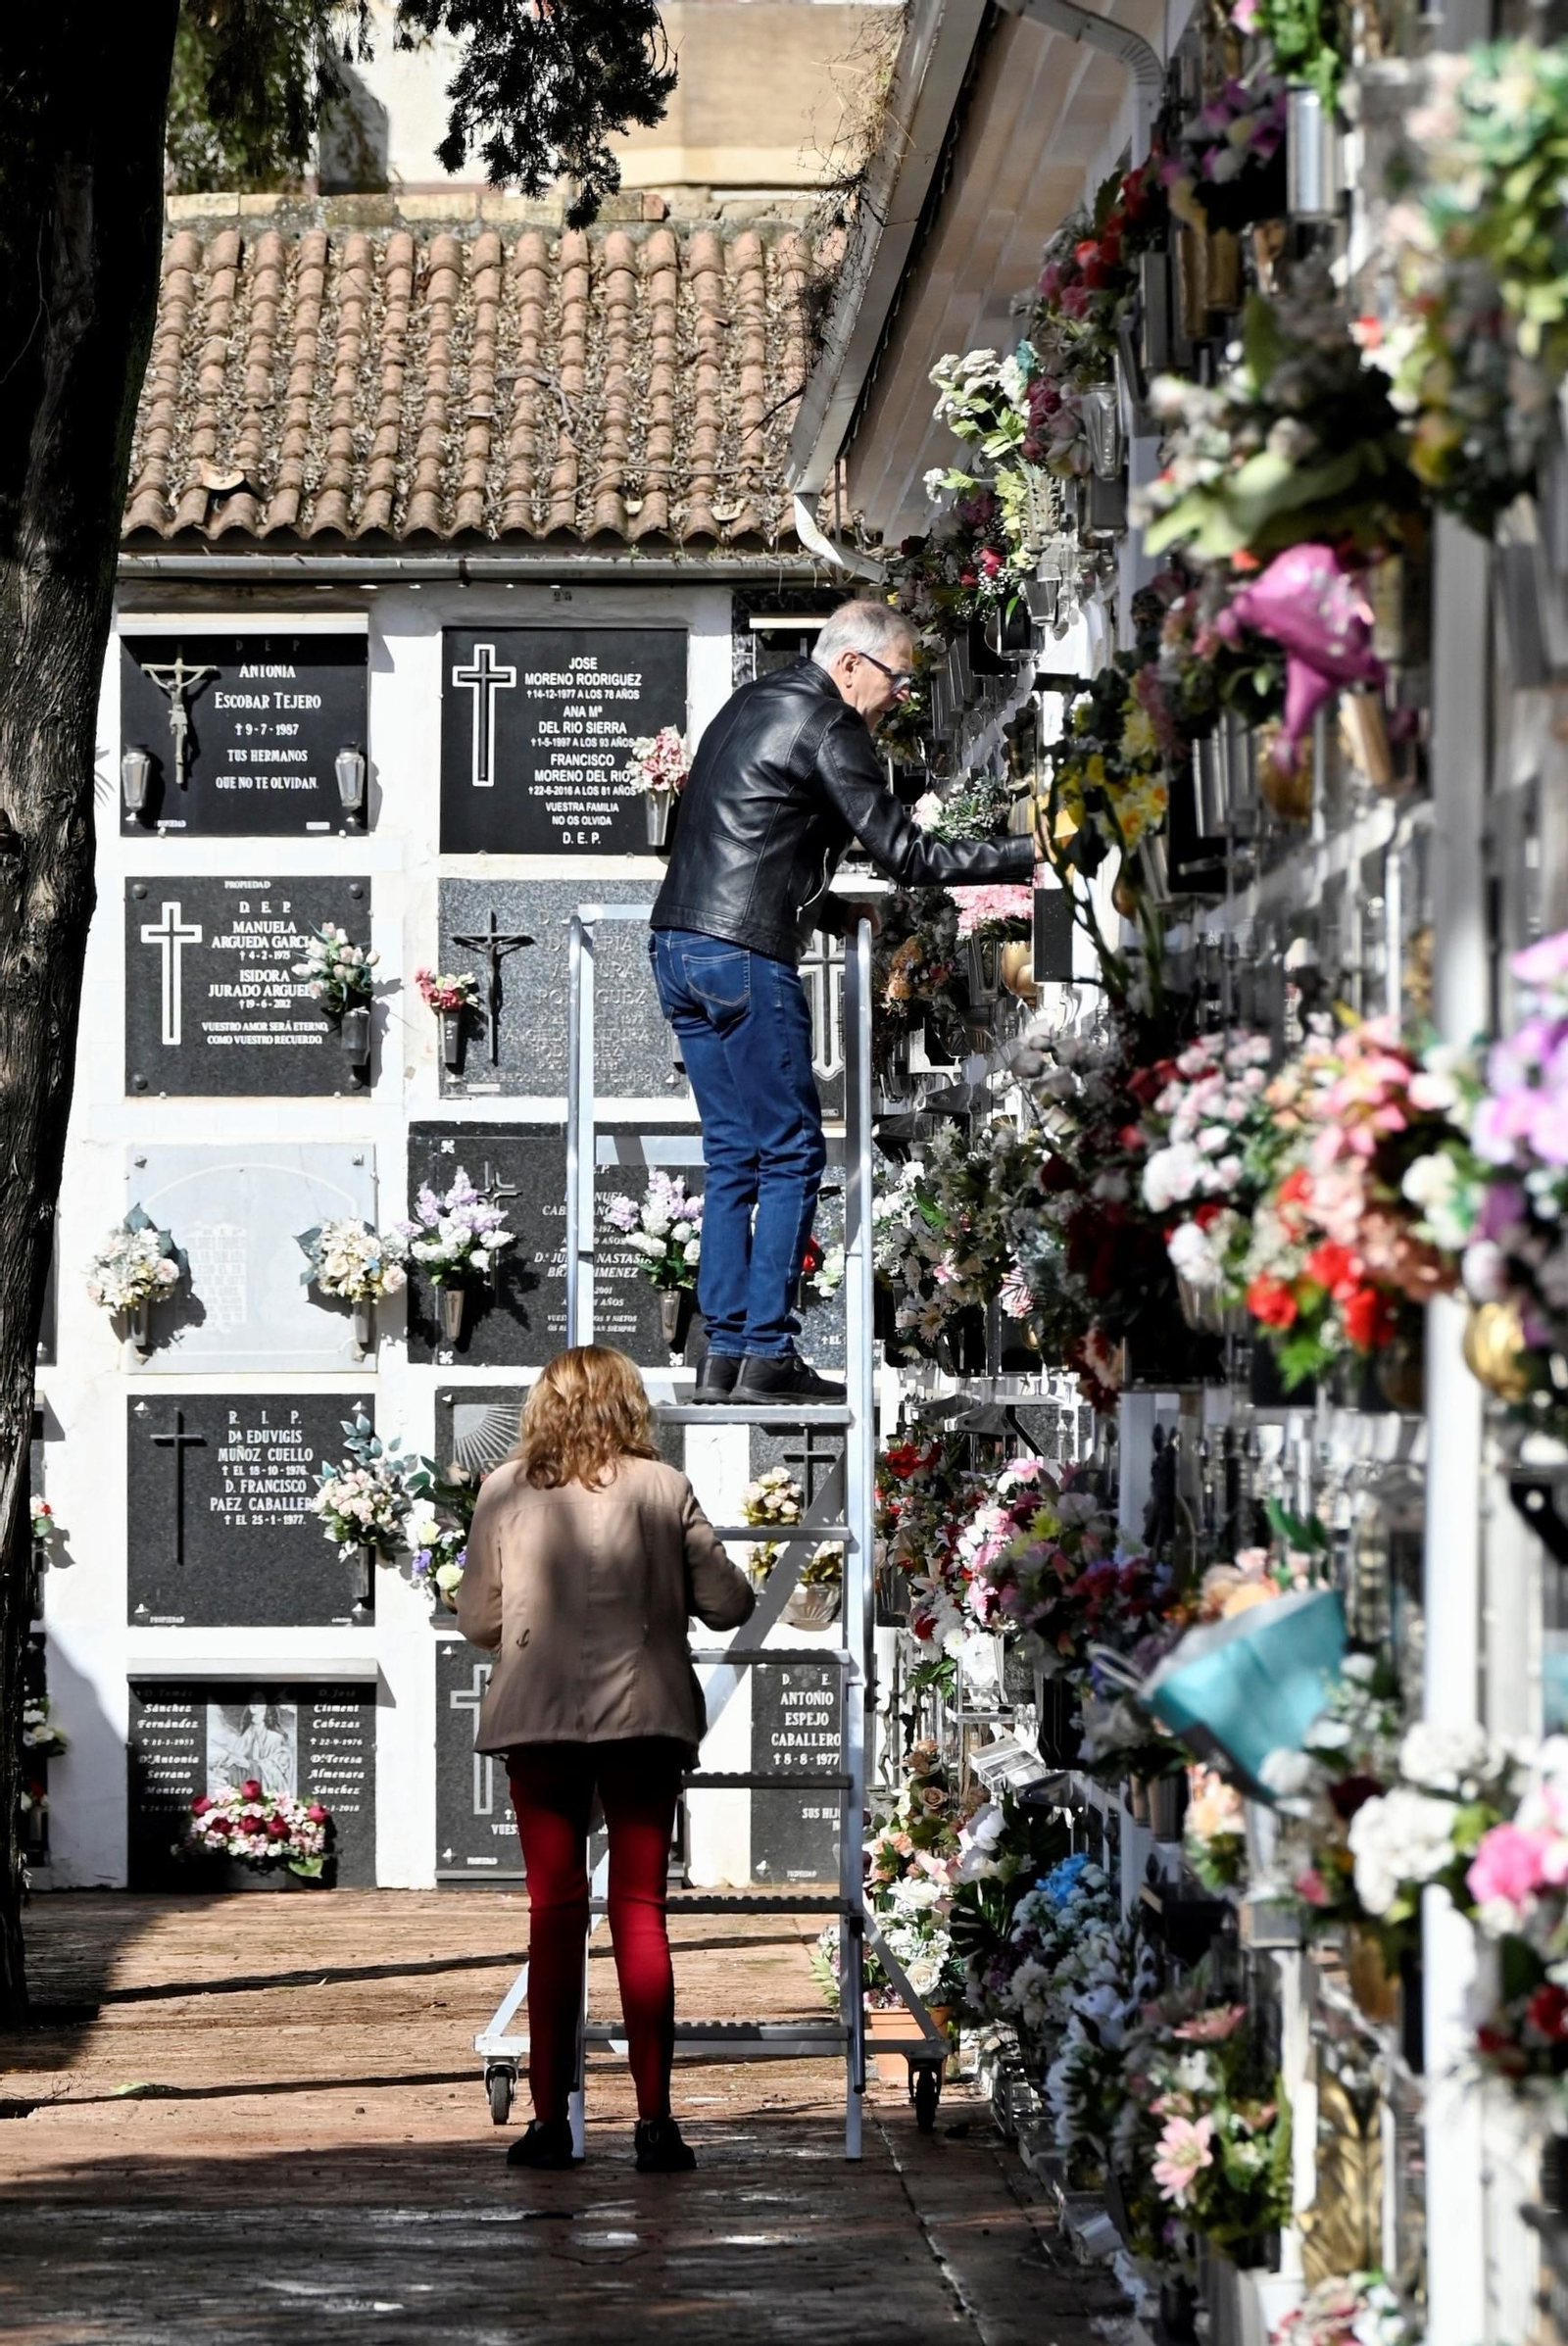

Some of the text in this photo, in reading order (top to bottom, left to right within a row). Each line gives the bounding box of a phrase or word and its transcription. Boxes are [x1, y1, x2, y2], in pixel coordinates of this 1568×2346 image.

[568, 658, 598, 669] JOSE
[238, 665, 297, 678] ANTONIA
[524, 673, 642, 686] MORENO RODRIGUEZ
[577, 690, 584, 700] A
[584, 690, 603, 700] LOS
[615, 688, 640, 700] AÑOS
[214, 692, 322, 709] ESCOBAR TEJERO
[563, 706, 586, 717] ANA
[538, 721, 627, 734] DEL RIO SIERRA
[573, 738, 579, 748] A
[580, 738, 598, 748] LOS
[611, 736, 634, 748] AÑOS
[226, 750, 309, 761] TUS HERMANOS
[550, 754, 615, 766] FRANCISCO
[534, 769, 630, 782] MORENO DEL RIO
[216, 776, 237, 789] QUE
[238, 777, 254, 789] NO
[255, 777, 269, 789] TE
[573, 786, 581, 796] A
[581, 786, 600, 796] LOS
[612, 784, 637, 796] AÑOS
[545, 802, 619, 812] VUESTRA FAMILIA
[552, 815, 612, 825] NO OS OLVIDA
[232, 921, 297, 933] MANUELA
[211, 936, 270, 949] ARGUEDA
[239, 969, 290, 982] ISIDORA
[208, 985, 316, 997] JURADO ARGUE
[243, 1022, 269, 1032] AMOR
[207, 1036, 233, 1045] COMO
[590, 1267, 639, 1278] IMENEZ
[246, 1430, 303, 1443] EDUVIGIS
[218, 1444, 314, 1461] MUÑOZ CUELLO
[232, 1466, 245, 1475] EL
[224, 1479, 307, 1492] D. FRANCISCO
[210, 1497, 242, 1511] PAEZ
[235, 1515, 247, 1525] EL
[779, 1692, 834, 1705] ANTONIO
[144, 1704, 192, 1713] Sánchez
[137, 1718, 199, 1729] Fernández
[313, 1718, 360, 1729] Cabezas
[784, 1713, 829, 1726] ESPEJO
[770, 1734, 842, 1746] CABALLERO
[324, 1754, 363, 1764] Teresa
[146, 1770, 191, 1779] Serrano
[307, 1768, 365, 1780] Almenara
[312, 1784, 361, 1794] Sánchez
[802, 1808, 842, 1819] SUS HIJ
